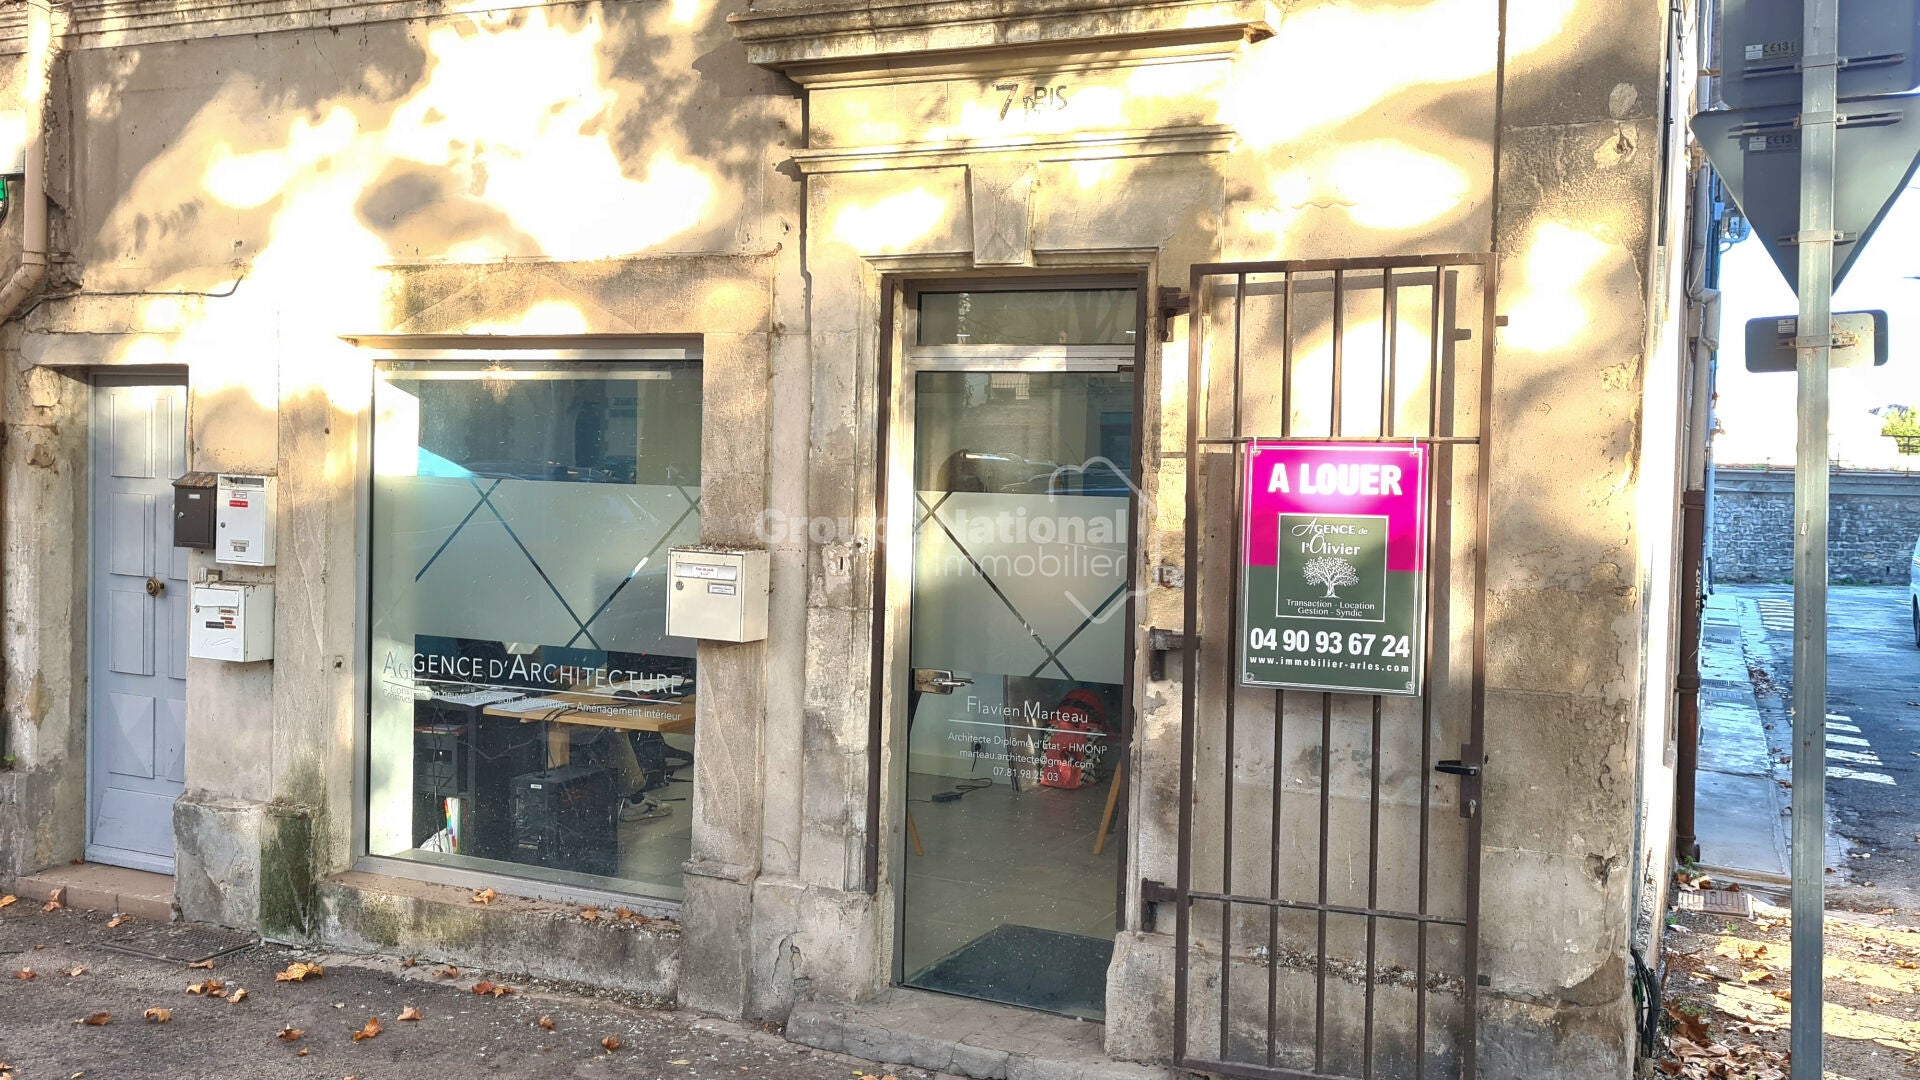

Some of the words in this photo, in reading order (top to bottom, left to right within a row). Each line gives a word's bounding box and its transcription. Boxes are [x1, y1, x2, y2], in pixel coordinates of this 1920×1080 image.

[995, 83, 1019, 121] 7
[1267, 463, 1289, 493] A
[1299, 463, 1402, 495] LOUER
[1291, 517, 1356, 537] AGENCE
[1358, 527, 1368, 535] de
[1301, 534, 1360, 556] l'Olivier
[1286, 599, 1332, 608] Transaction
[1340, 601, 1375, 610] Location
[1297, 607, 1328, 615] Gestion
[1336, 609, 1363, 618] Syndic
[1250, 627, 1277, 650] 04
[1282, 629, 1310, 652] 90
[1315, 631, 1342, 654] 93
[1348, 632, 1376, 656] 67
[1381, 634, 1410, 657] 24
[489, 654, 682, 696] D'ARCHITECTURE
[1250, 656, 1409, 673] www.immobilier-arles.com
[577, 701, 642, 718] Aménagement
[644, 709, 682, 721] intérieur
[966, 695, 1020, 717] Flavien
[1024, 700, 1088, 724] Marteau
[948, 731, 991, 744] Architecte
[1068, 744, 1108, 755] HMONP
[959, 748, 1095, 769] marteau.architecte@gmail.com
